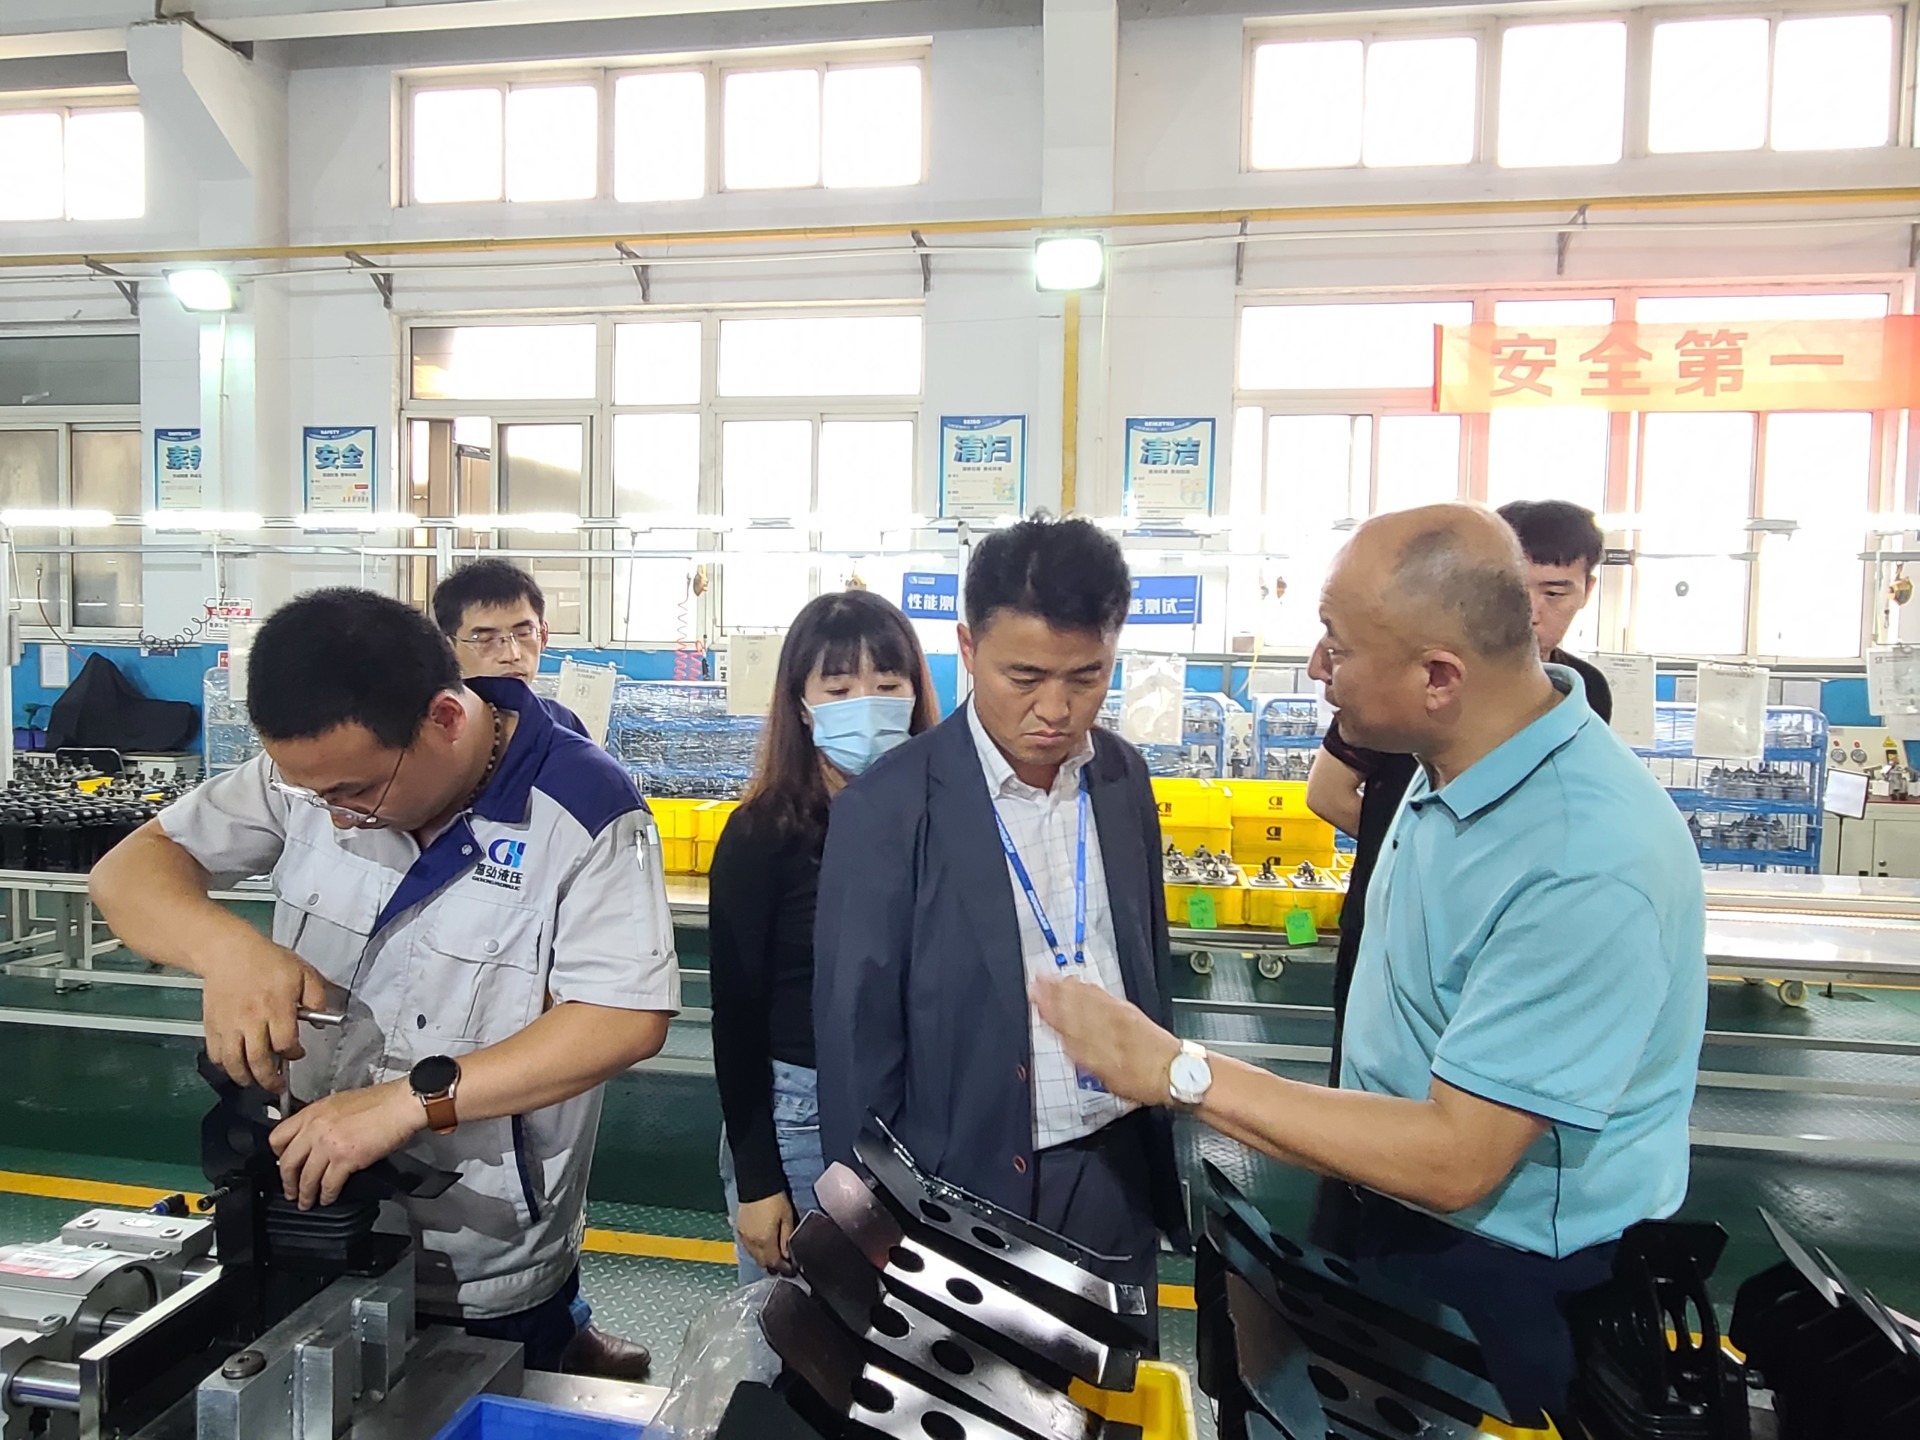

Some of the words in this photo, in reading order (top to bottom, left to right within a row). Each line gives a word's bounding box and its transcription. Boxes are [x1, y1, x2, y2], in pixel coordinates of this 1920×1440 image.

[1489, 328, 1845, 397] 安全第一
[315, 443, 364, 470] 安全
[953, 433, 1012, 463] 清扫
[1140, 436, 1201, 466] 清洁
